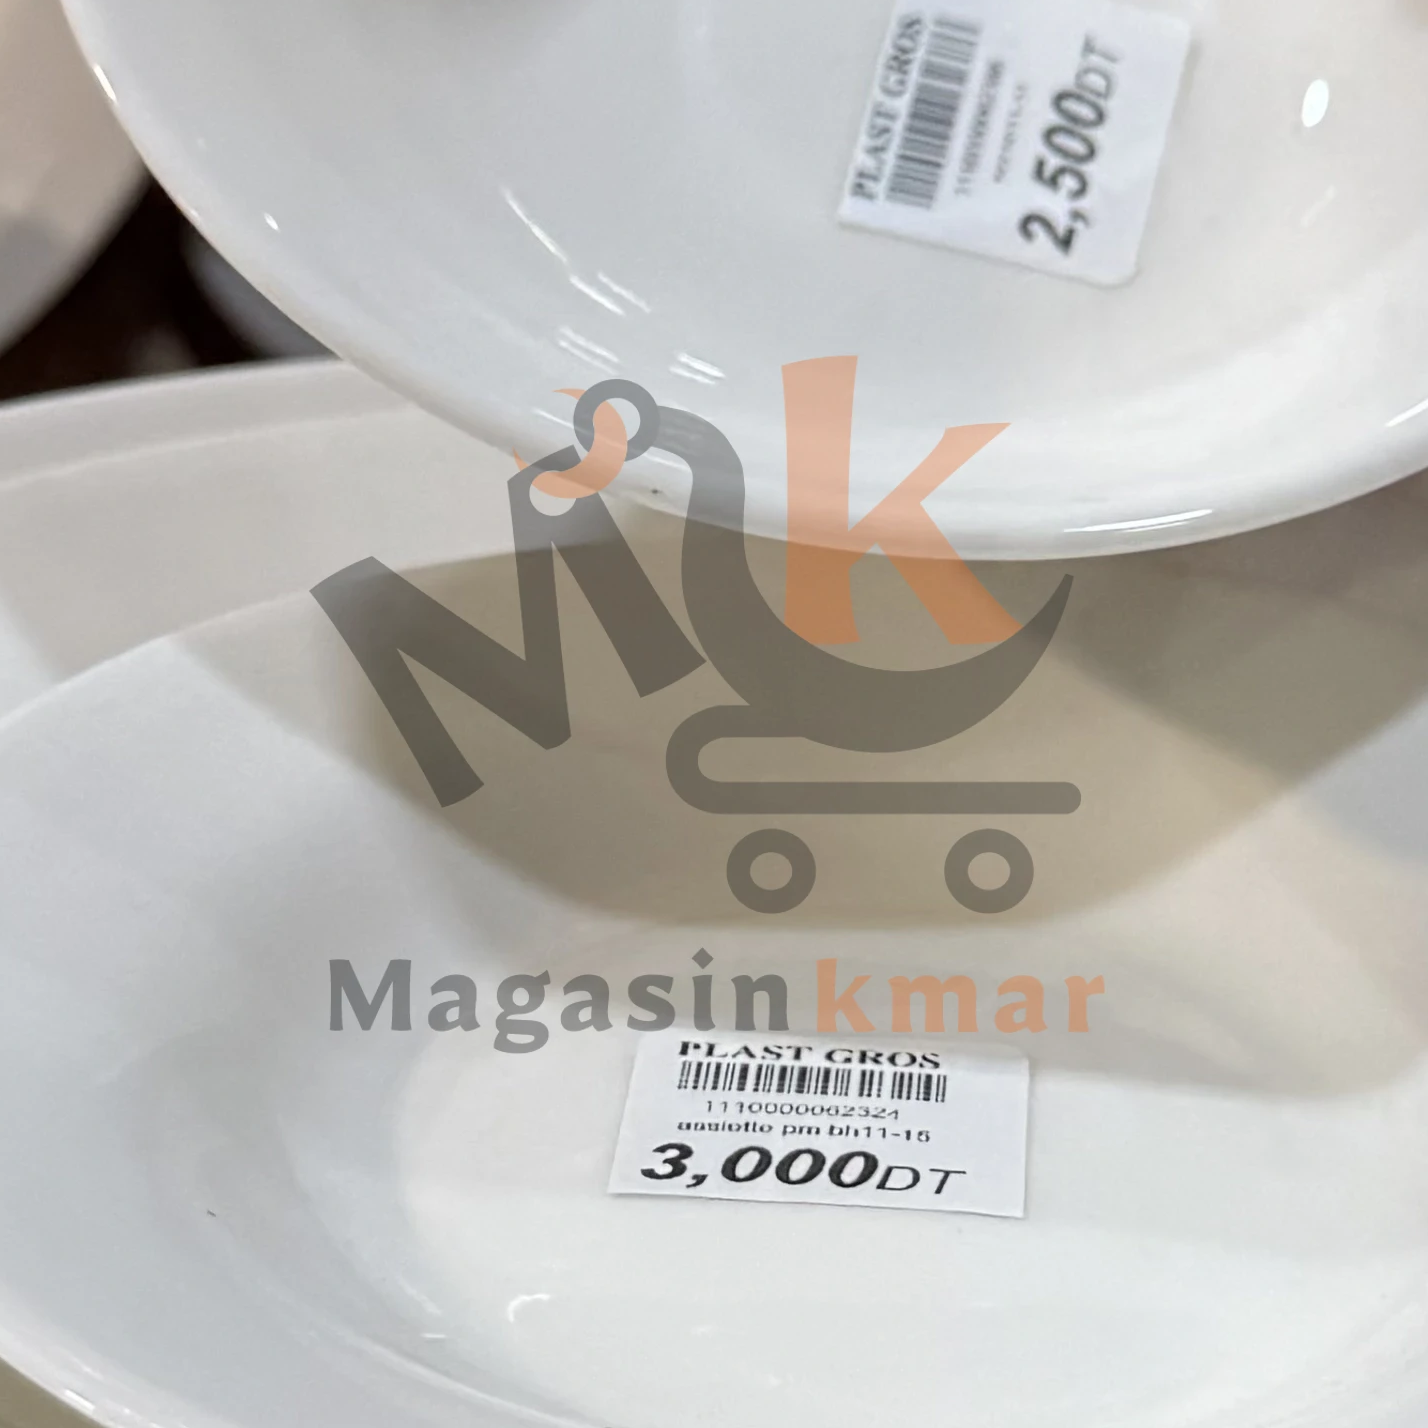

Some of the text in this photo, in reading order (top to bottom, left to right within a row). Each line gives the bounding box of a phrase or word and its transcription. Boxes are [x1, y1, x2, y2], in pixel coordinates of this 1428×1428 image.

[850, 14, 922, 201] PLAST GROS
[678, 1041, 941, 1070] PLAST GROS
[640, 1142, 967, 1196] 3,000DT
